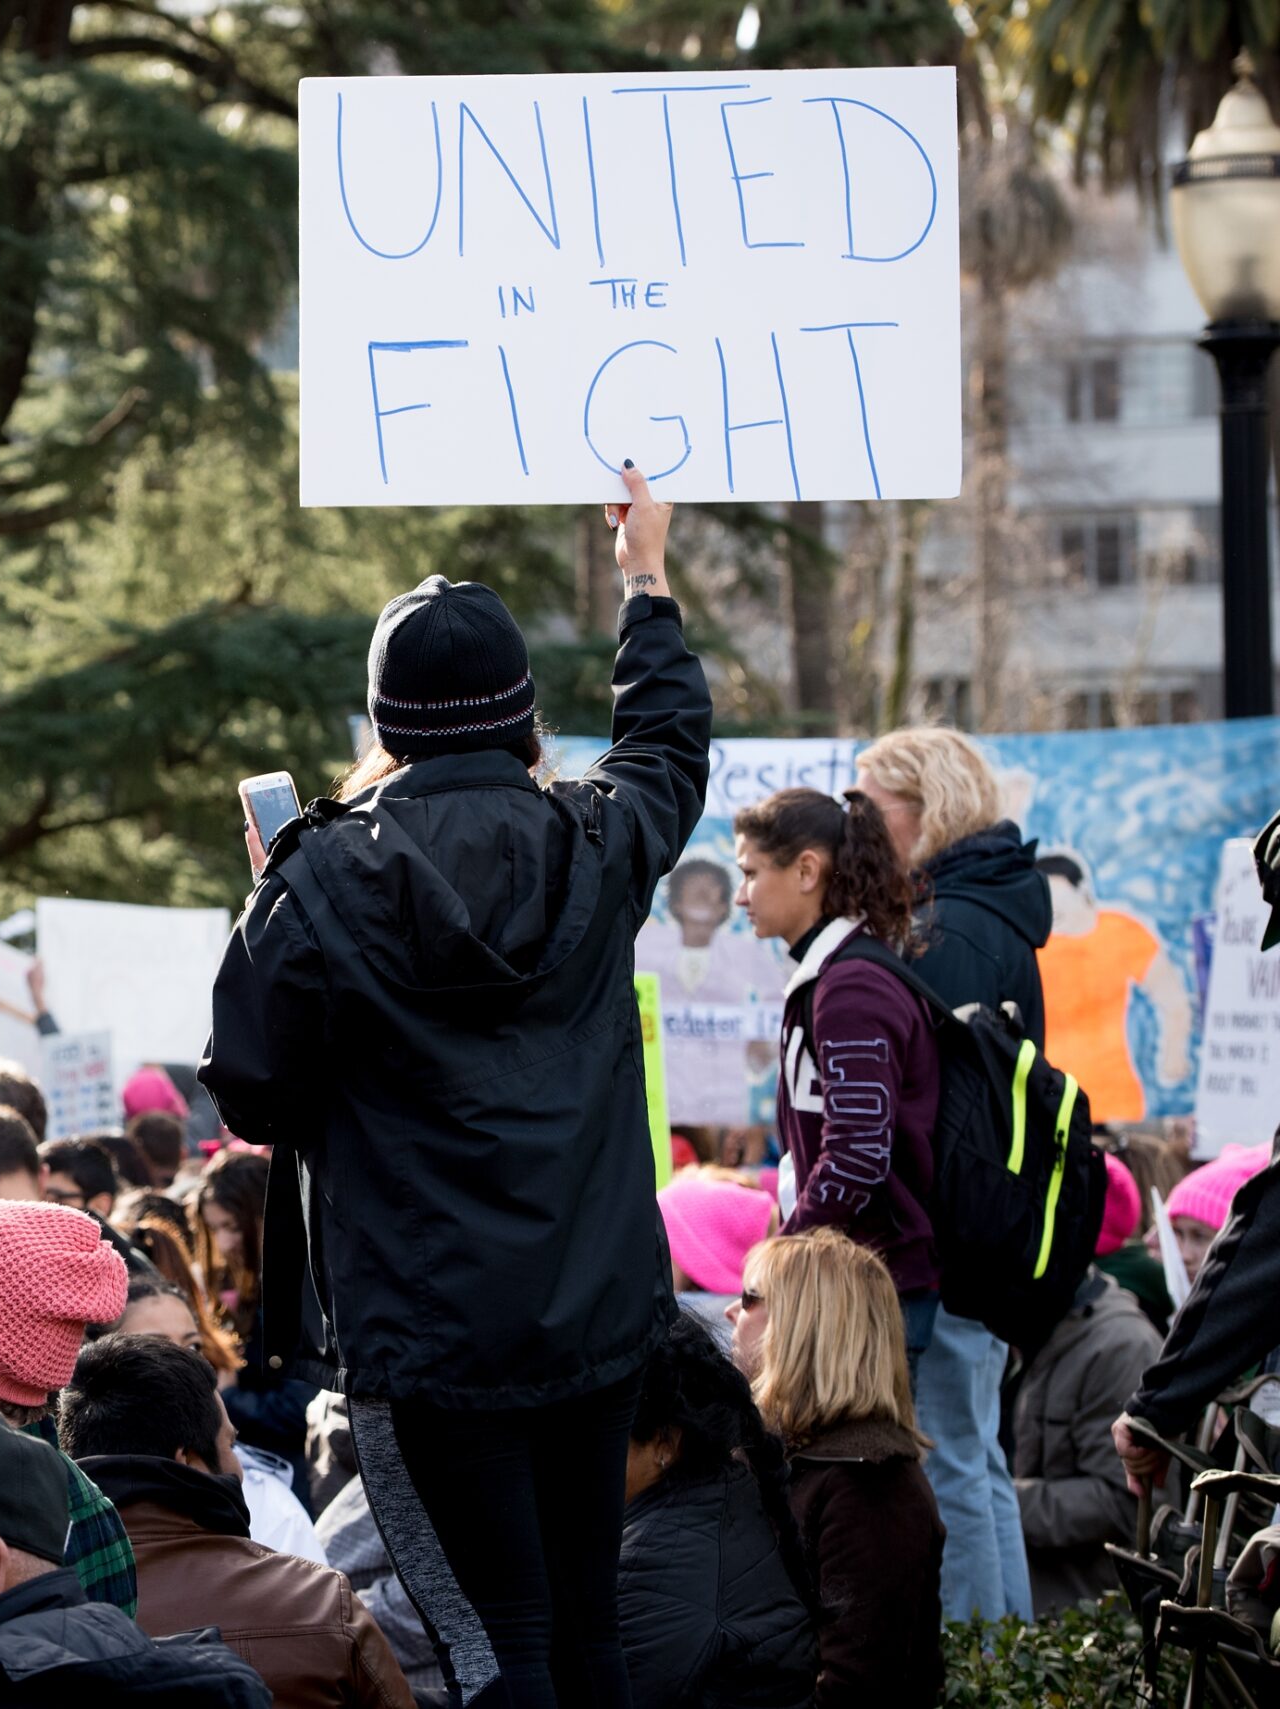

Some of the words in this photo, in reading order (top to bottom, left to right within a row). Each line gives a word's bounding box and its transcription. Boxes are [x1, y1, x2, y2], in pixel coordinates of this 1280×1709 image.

[337, 84, 936, 268] UNITED
[498, 285, 535, 318] IN
[589, 278, 669, 310] THE
[368, 322, 899, 500] FIGHT
[806, 1038, 892, 1216] LOVE
